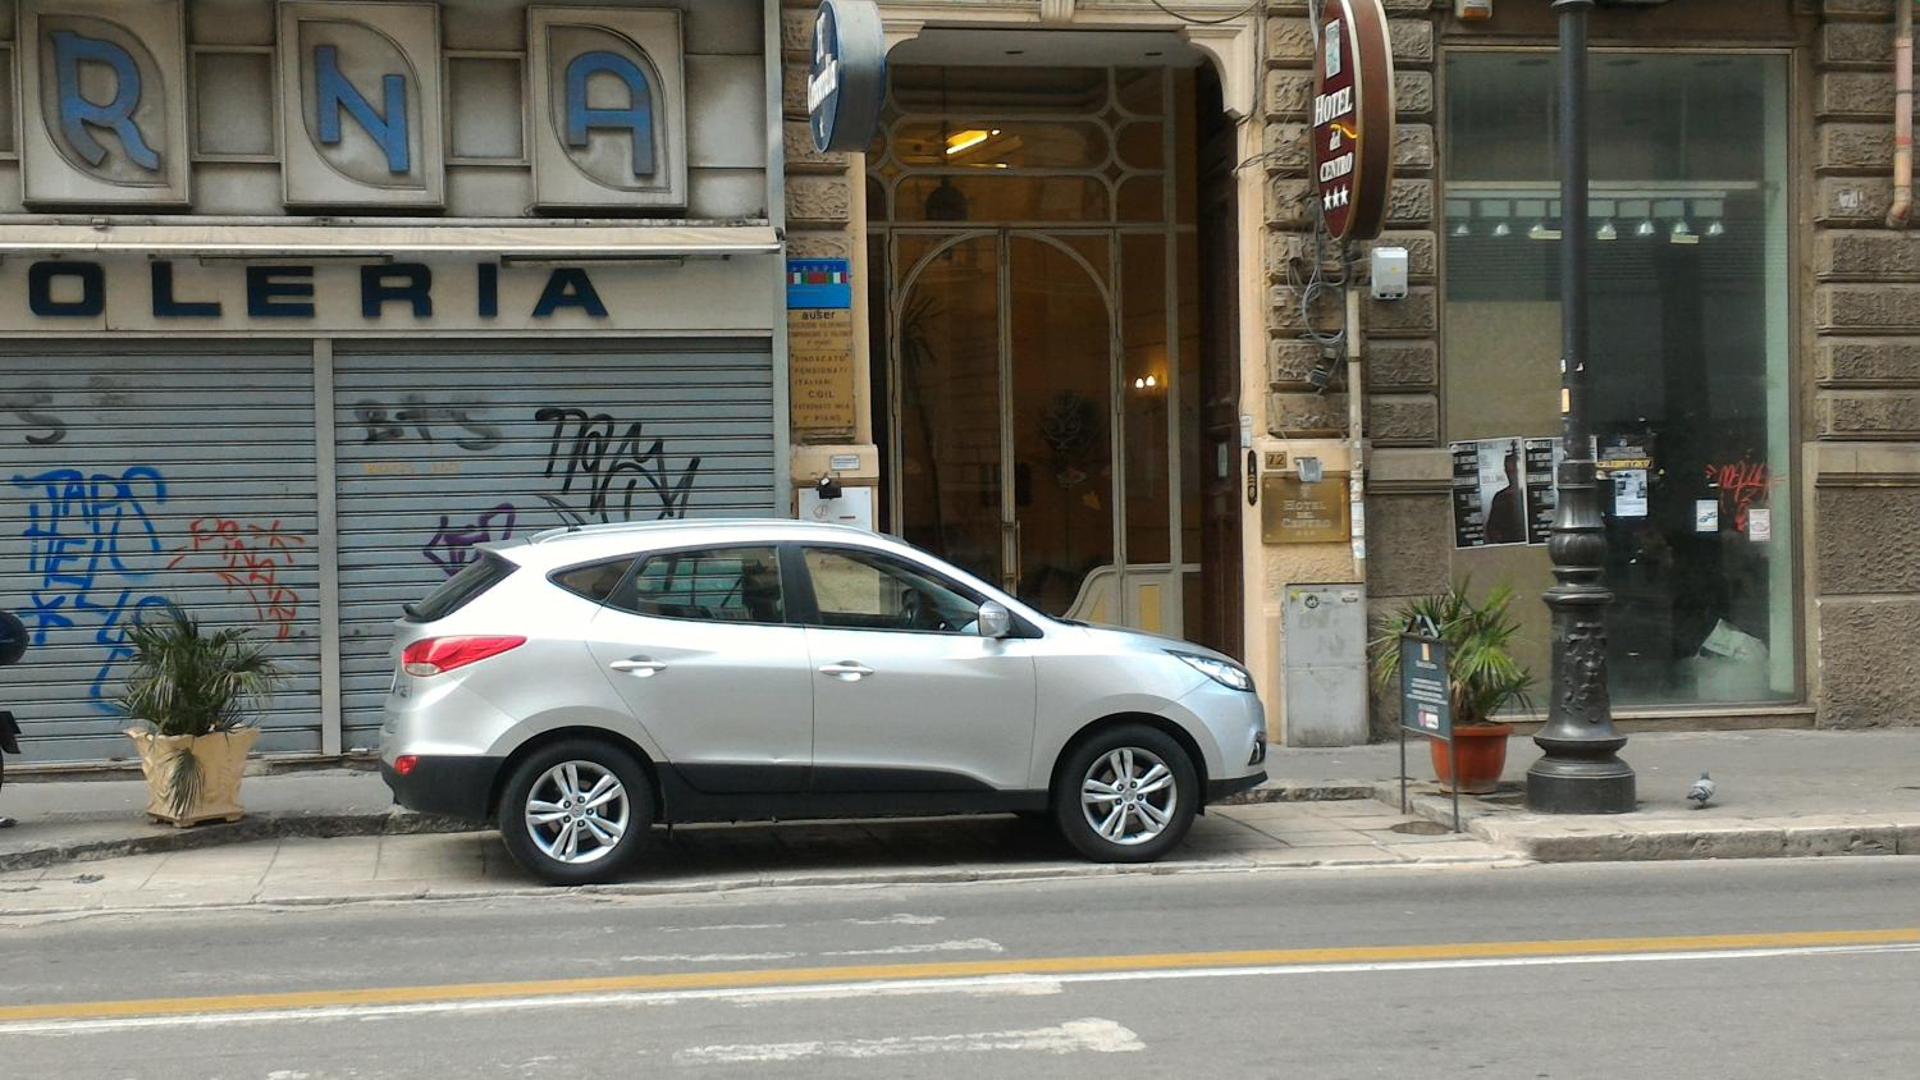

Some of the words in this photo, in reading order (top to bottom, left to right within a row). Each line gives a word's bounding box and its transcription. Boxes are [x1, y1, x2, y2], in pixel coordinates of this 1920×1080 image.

[1314, 87, 1352, 127] HOTEL
[1320, 153, 1353, 182] CENTRO
[801, 310, 836, 320] auser
[1269, 453, 1286, 466] 72
